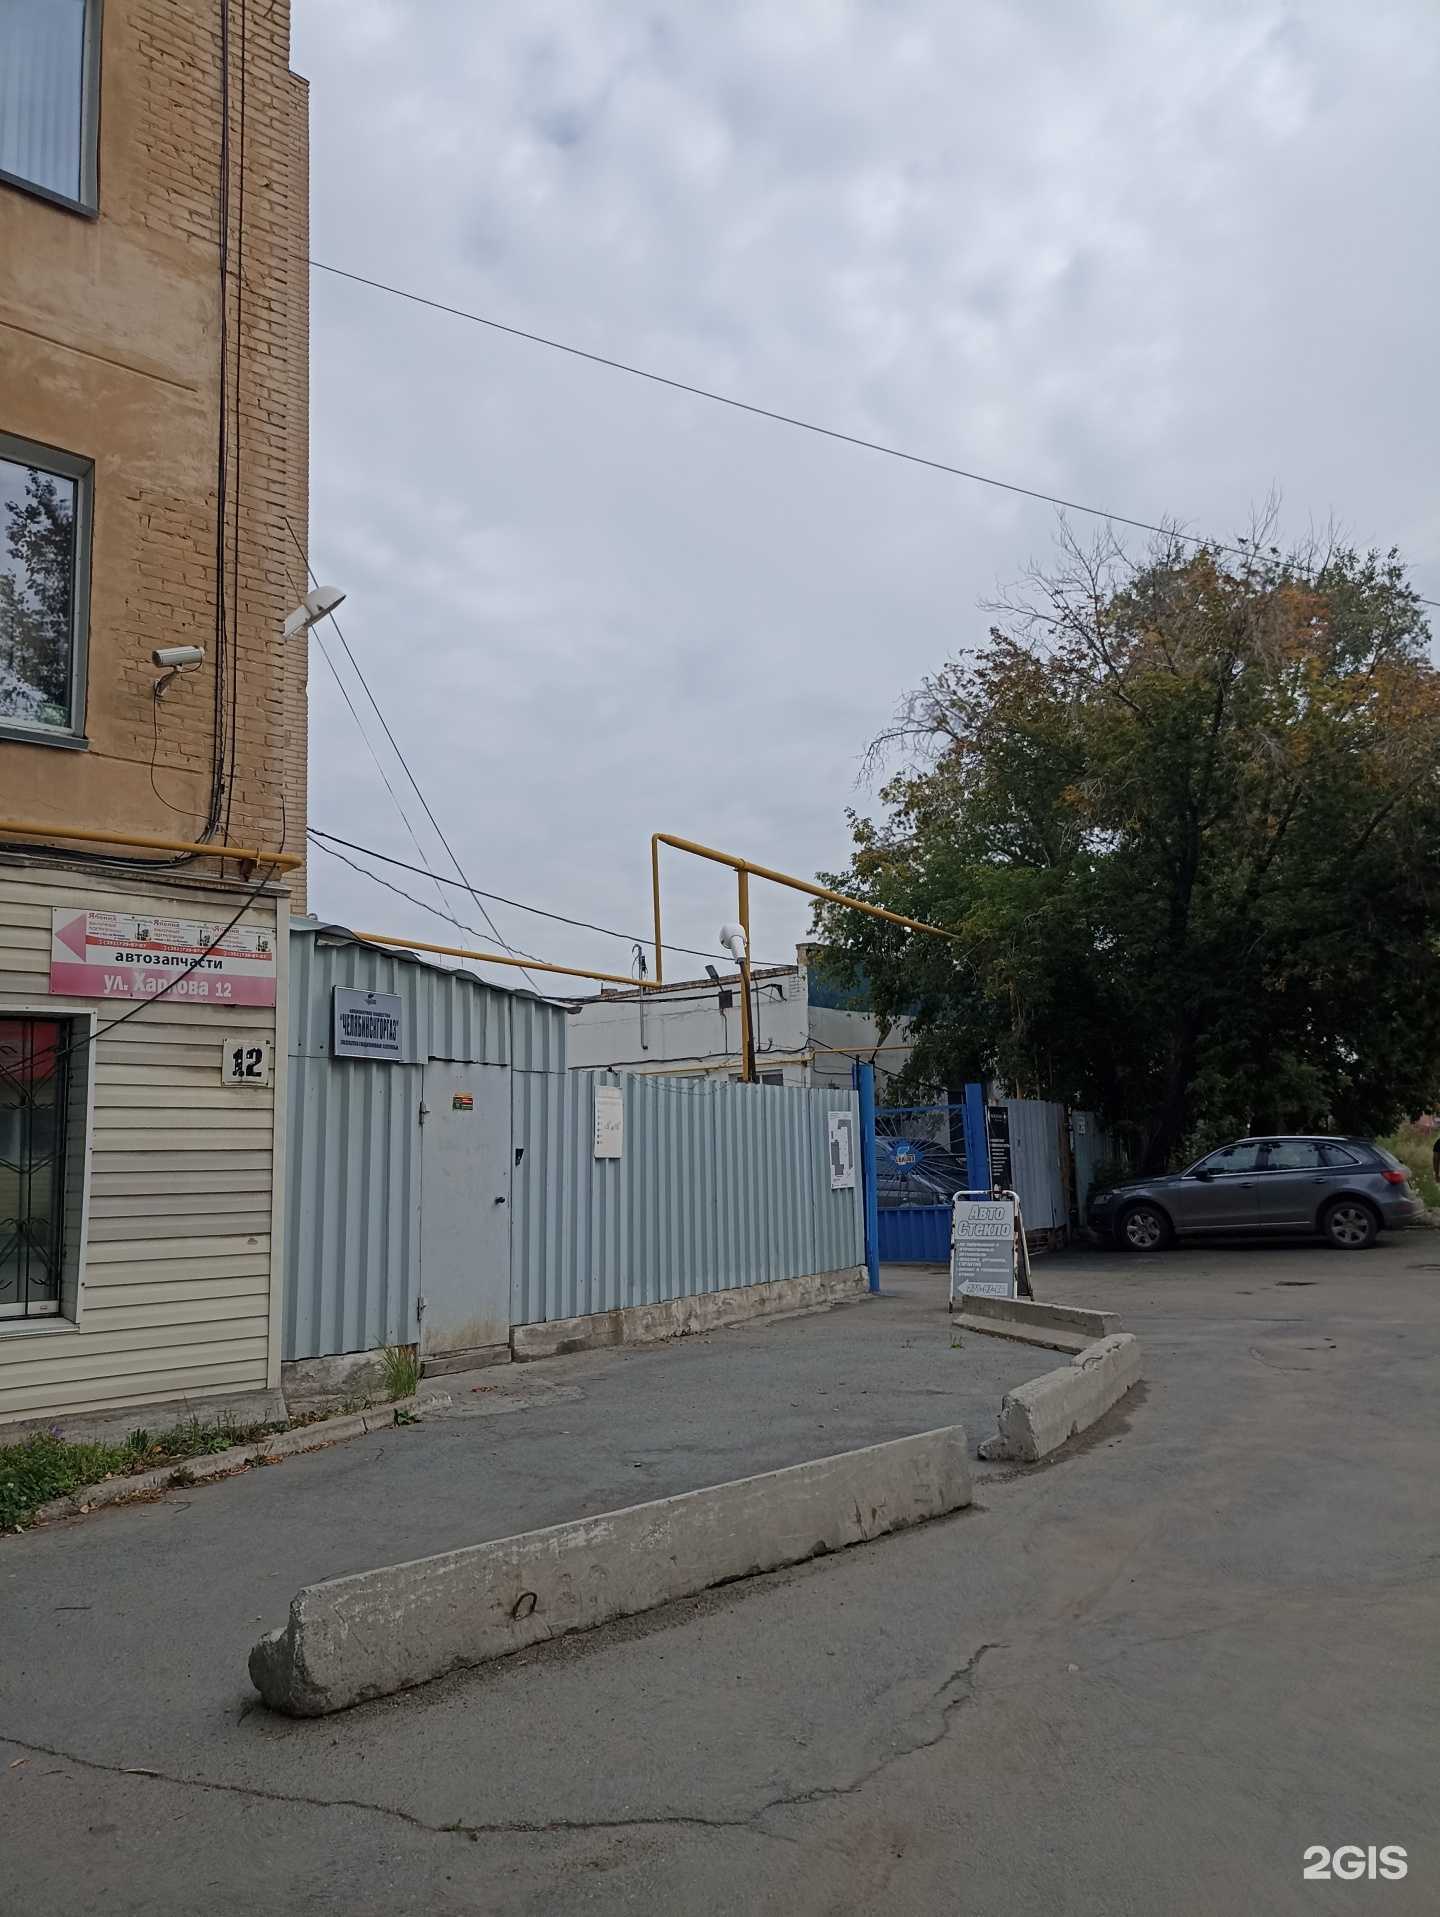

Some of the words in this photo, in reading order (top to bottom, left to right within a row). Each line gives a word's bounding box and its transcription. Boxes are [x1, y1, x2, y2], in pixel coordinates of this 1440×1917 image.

[115, 952, 223, 969] автозапчасти
[104, 974, 128, 994] ул.
[215, 982, 232, 998] 12
[232, 1047, 263, 1077] 12
